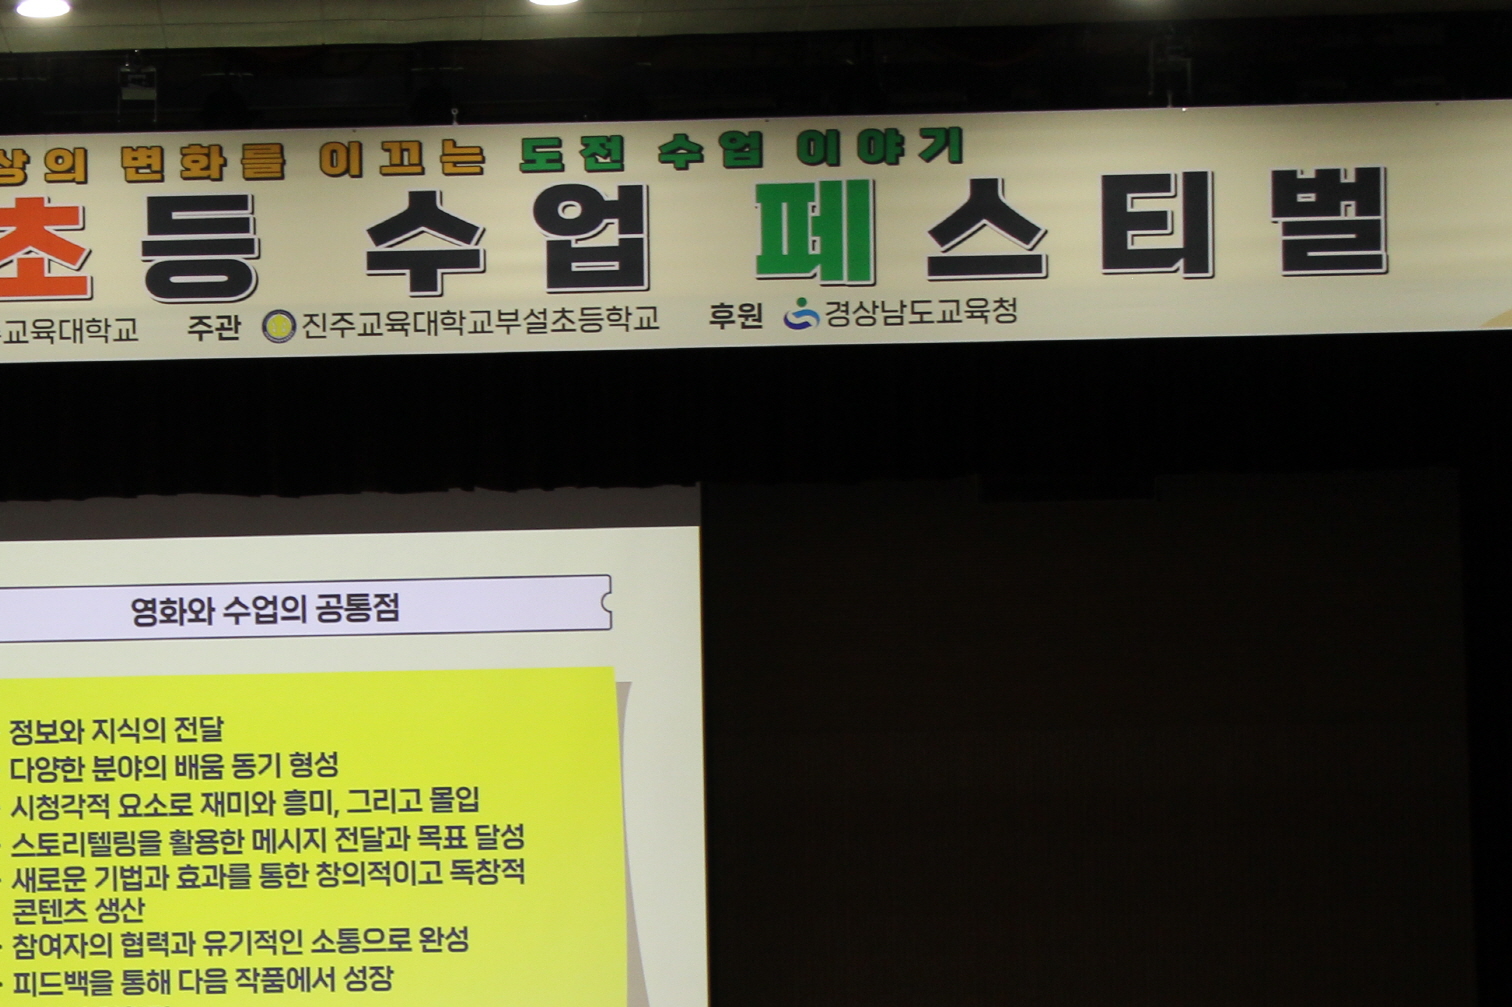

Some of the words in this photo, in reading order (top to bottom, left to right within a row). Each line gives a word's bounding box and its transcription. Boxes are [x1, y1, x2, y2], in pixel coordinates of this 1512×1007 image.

[120, 141, 286, 183] 변화를
[319, 137, 486, 179] 이끄는
[520, 135, 624, 173] 도전
[658, 130, 764, 170] 수업
[796, 125, 966, 167] 이야기
[362, 184, 650, 298] 수업
[754, 165, 1389, 288] 페스티벌
[188, 315, 241, 341] 주관
[303, 306, 659, 339] 진주교육대학교부설초등학교
[710, 303, 762, 329] 후원
[826, 298, 1017, 327] 경상남도교육청
[131, 597, 215, 627] 영화와
[223, 595, 306, 625] 수업의
[316, 593, 398, 623] 공통점
[10, 719, 85, 745] 정보와
[92, 717, 165, 744] 지식의
[175, 716, 224, 742] 전달
[11, 756, 85, 783] 다양한
[92, 755, 166, 782] 분야의
[175, 754, 224, 780] 배움
[232, 753, 280, 779] 동기
[289, 752, 338, 778] 형성
[11, 794, 109, 820] 시청각적
[118, 793, 193, 817] 요소로
[201, 791, 276, 817] 재미와
[283, 789, 339, 818] 흥미,
[347, 788, 423, 814] 그리고
[430, 787, 478, 813] 몰입
[11, 830, 162, 857] 스토리텔링을
[169, 829, 245, 856] 활용한
[253, 827, 326, 854] 메시지
[335, 826, 411, 852] 전달과
[417, 825, 468, 851] 목표
[475, 824, 524, 850] 달성
[12, 866, 87, 893] 새로운
[95, 865, 169, 891] 기법과
[177, 863, 252, 889] 효과를
[259, 862, 309, 889] 통한
[316, 861, 443, 888] 창의적이고
[450, 858, 524, 885] 독창적
[13, 898, 88, 925] 콘텐츠
[95, 897, 145, 923] 생산
[13, 933, 112, 960] 참여자의
[121, 931, 196, 958] 협력과
[203, 929, 303, 956] 유기적인
[311, 928, 412, 954] 소통으로
[419, 926, 468, 952] 완성
[14, 970, 113, 997] 피드백을
[121, 969, 170, 995] 통해
[179, 968, 228, 994] 다음
[236, 967, 335, 993] 작품에서
[344, 966, 394, 991] 성장
